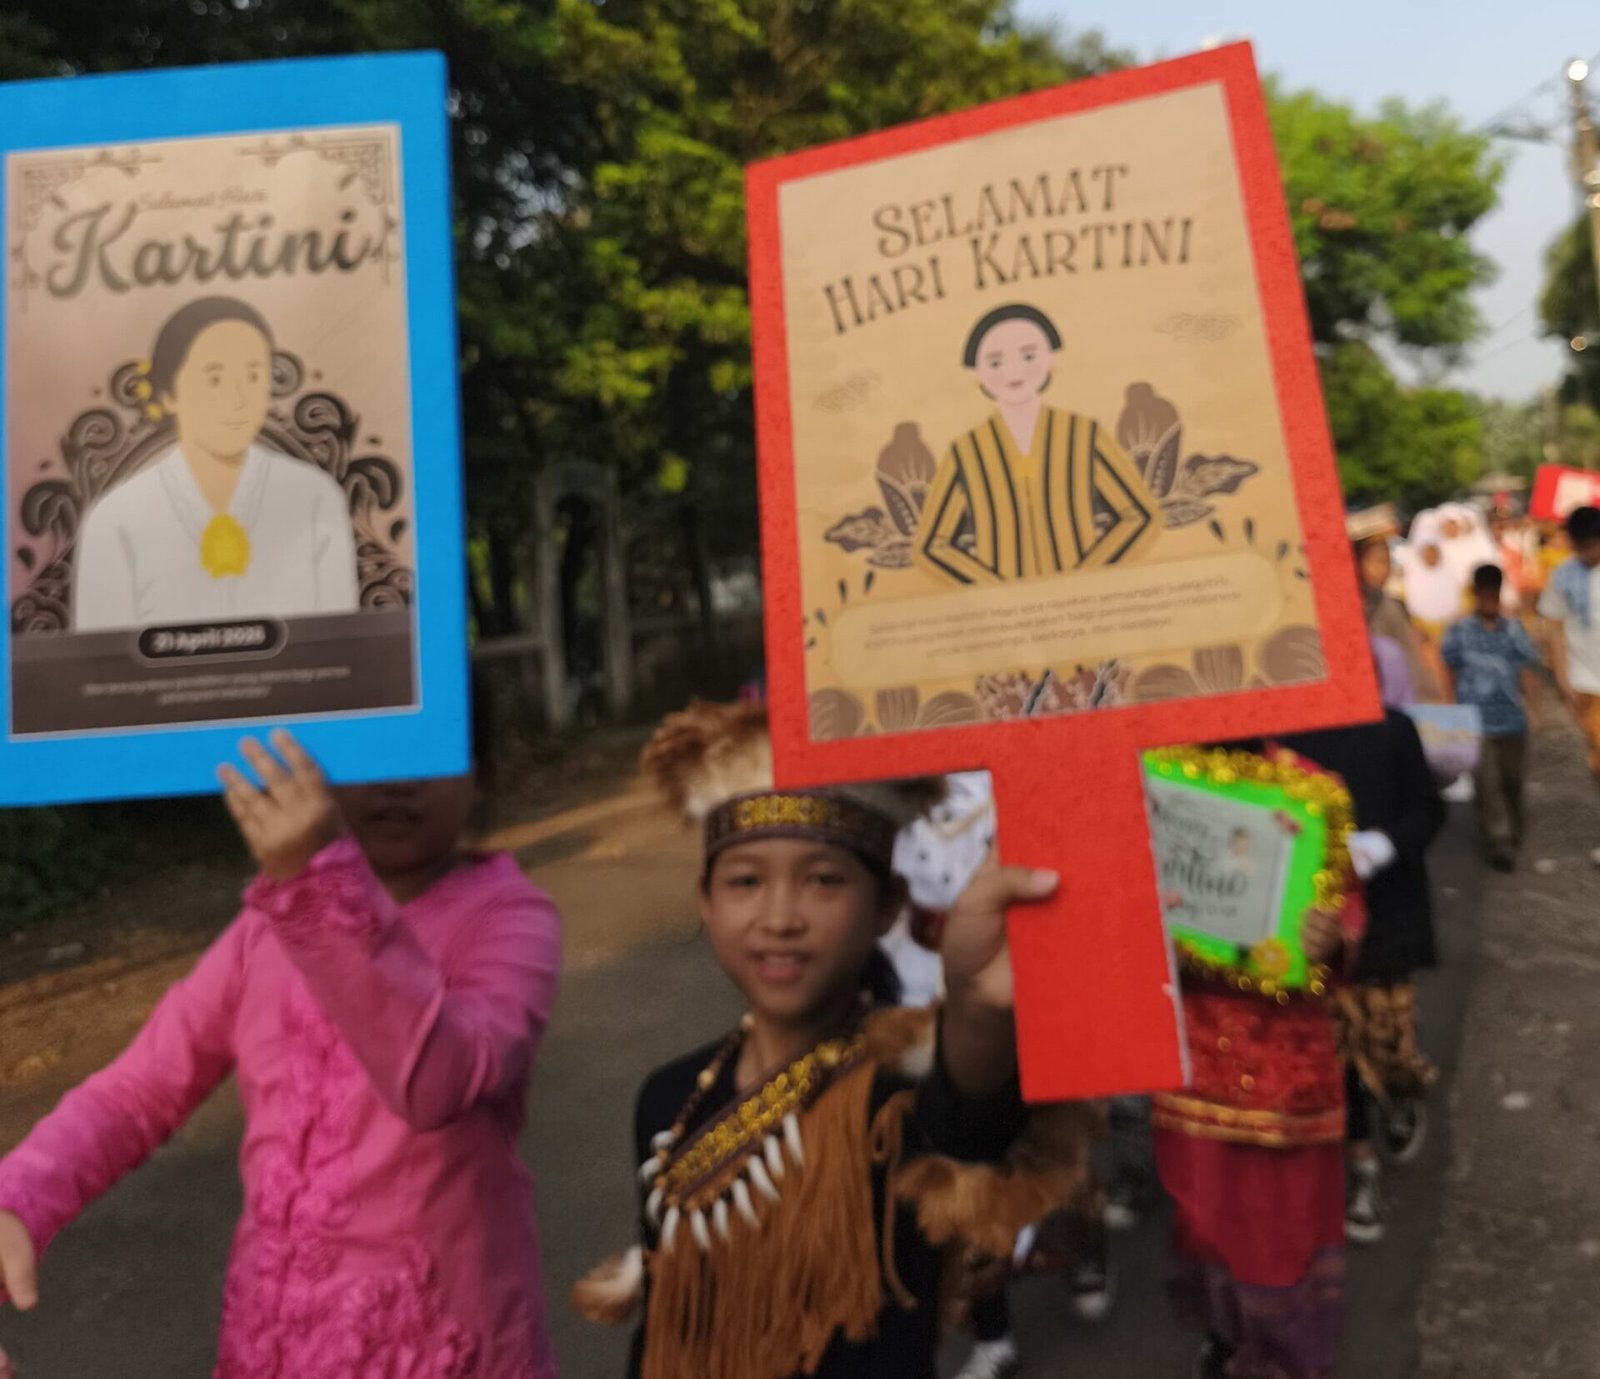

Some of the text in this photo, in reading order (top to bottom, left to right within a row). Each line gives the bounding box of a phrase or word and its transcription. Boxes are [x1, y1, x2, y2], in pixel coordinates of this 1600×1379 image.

[47, 202, 371, 298] Kartini
[821, 216, 1196, 336] HARI KARTINI
